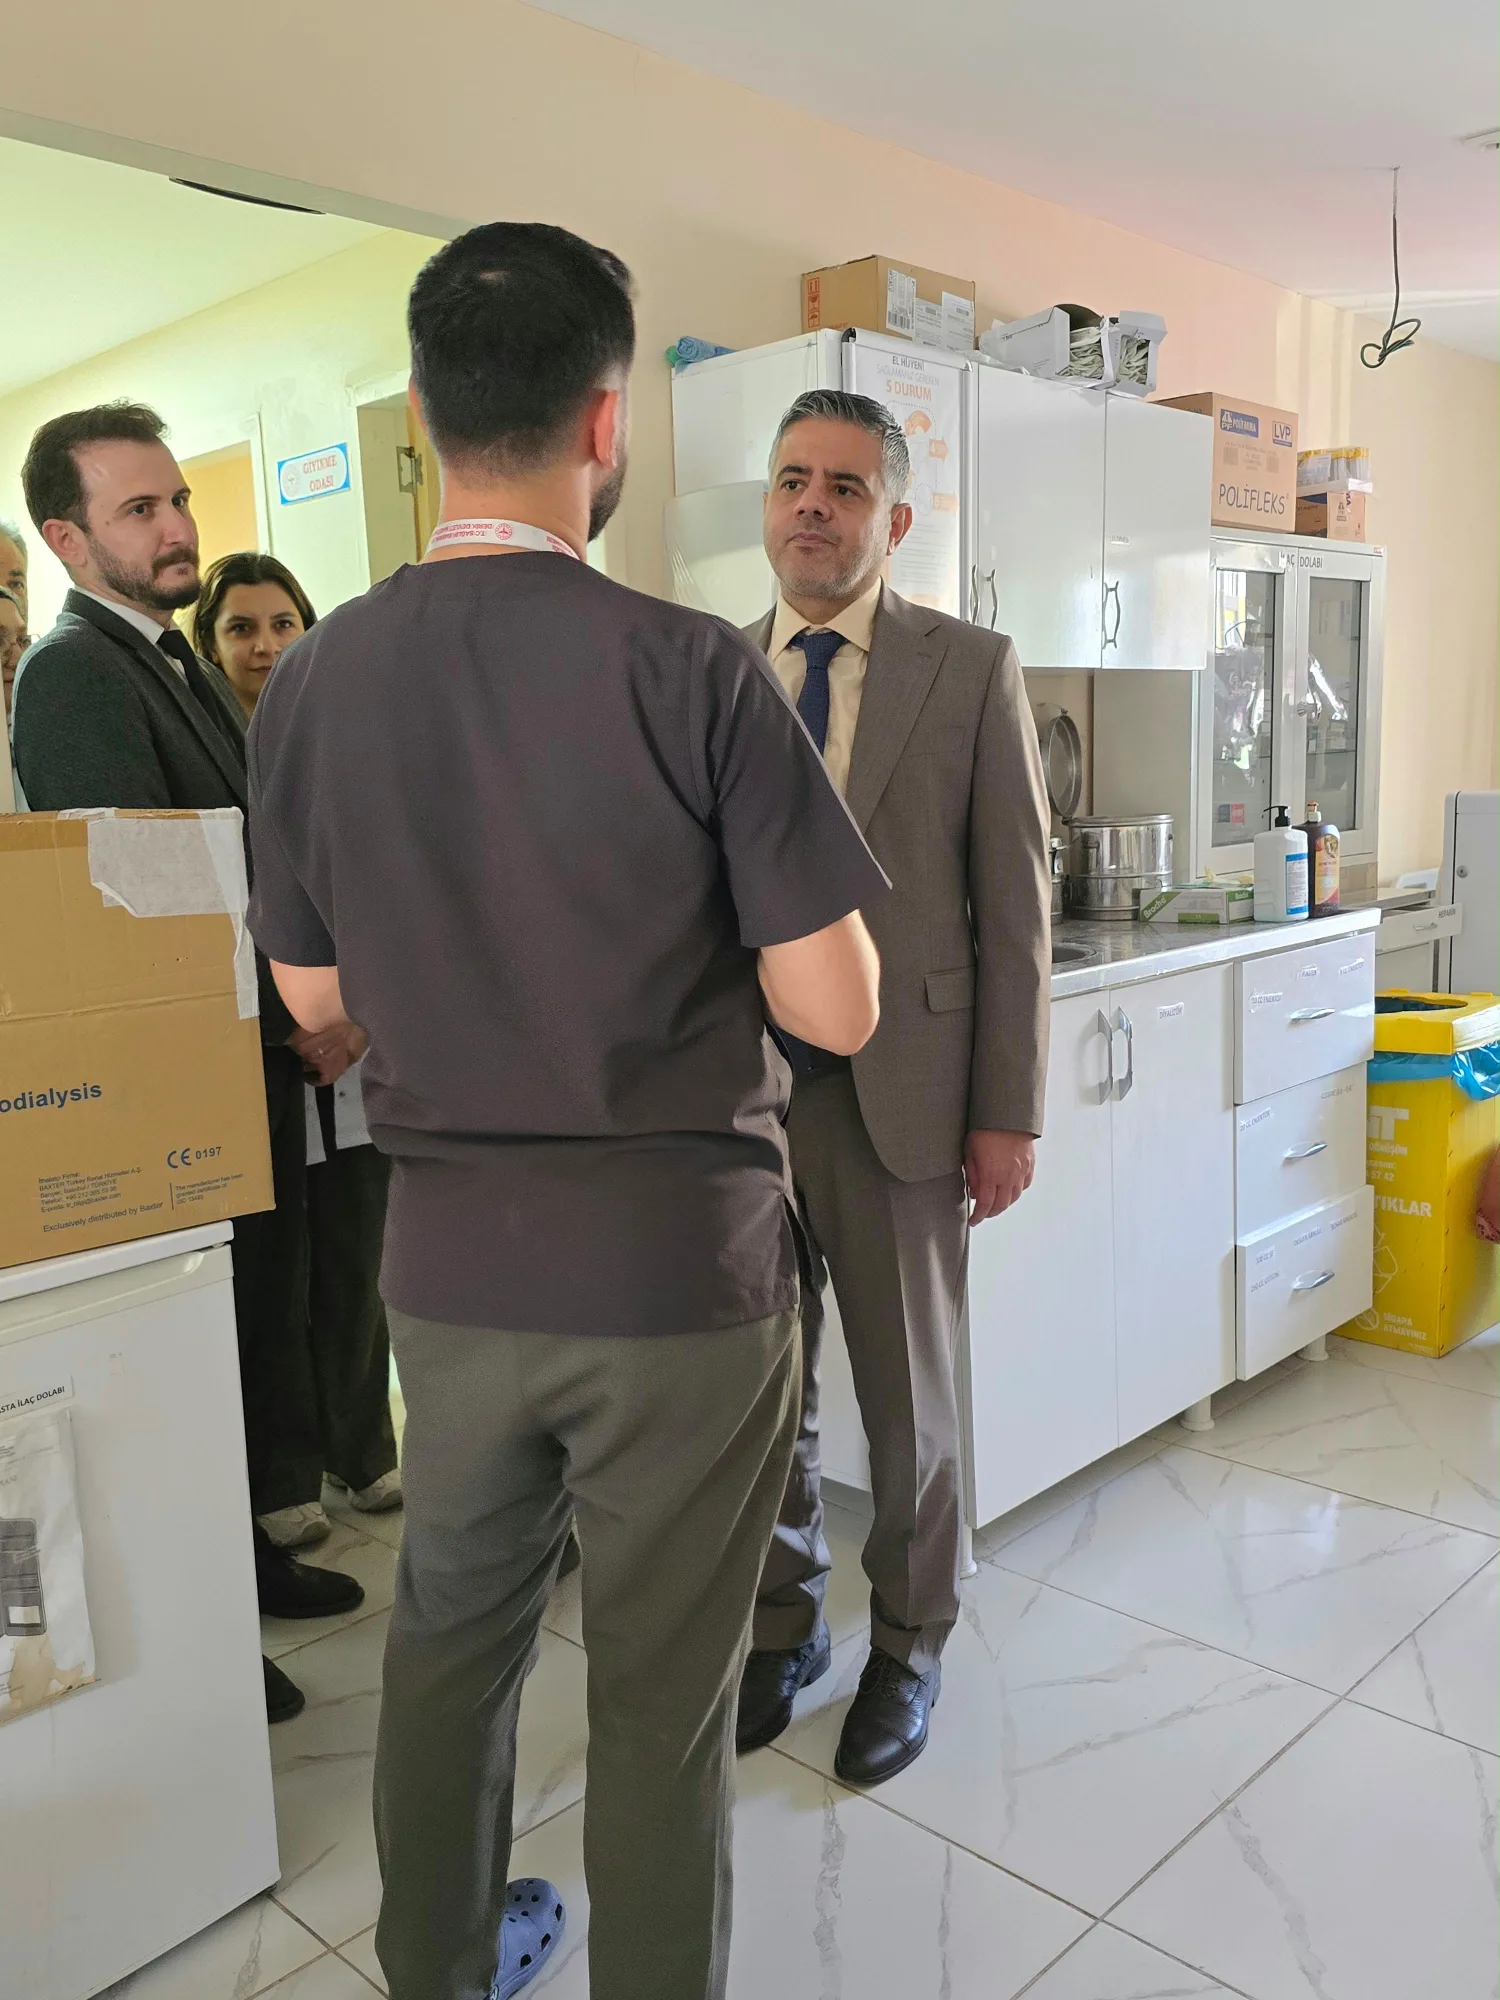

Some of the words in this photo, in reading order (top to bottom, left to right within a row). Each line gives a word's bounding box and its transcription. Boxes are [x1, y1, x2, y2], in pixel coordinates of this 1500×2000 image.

[886, 380, 892, 393] 5
[894, 381, 932, 401] DURUM
[1274, 423, 1291, 440] LVP
[1219, 484, 1285, 515] POLİFLEKS
[1300, 556, 1323, 569] DOLABI
[195, 1146, 222, 1160] 0197
[39, 1182, 65, 1191] BAXTER
[43, 1218, 87, 1232] Exclusively
[88, 1210, 127, 1223] distributed
[128, 1207, 138, 1216] by
[140, 1202, 164, 1213] Baxter
[1383, 1324, 1427, 1340] ATMAYINIZ
[0, 1403, 16, 1413] STA
[17, 1396, 35, 1407] İLAÇ
[37, 1386, 65, 1401] DOLABI
